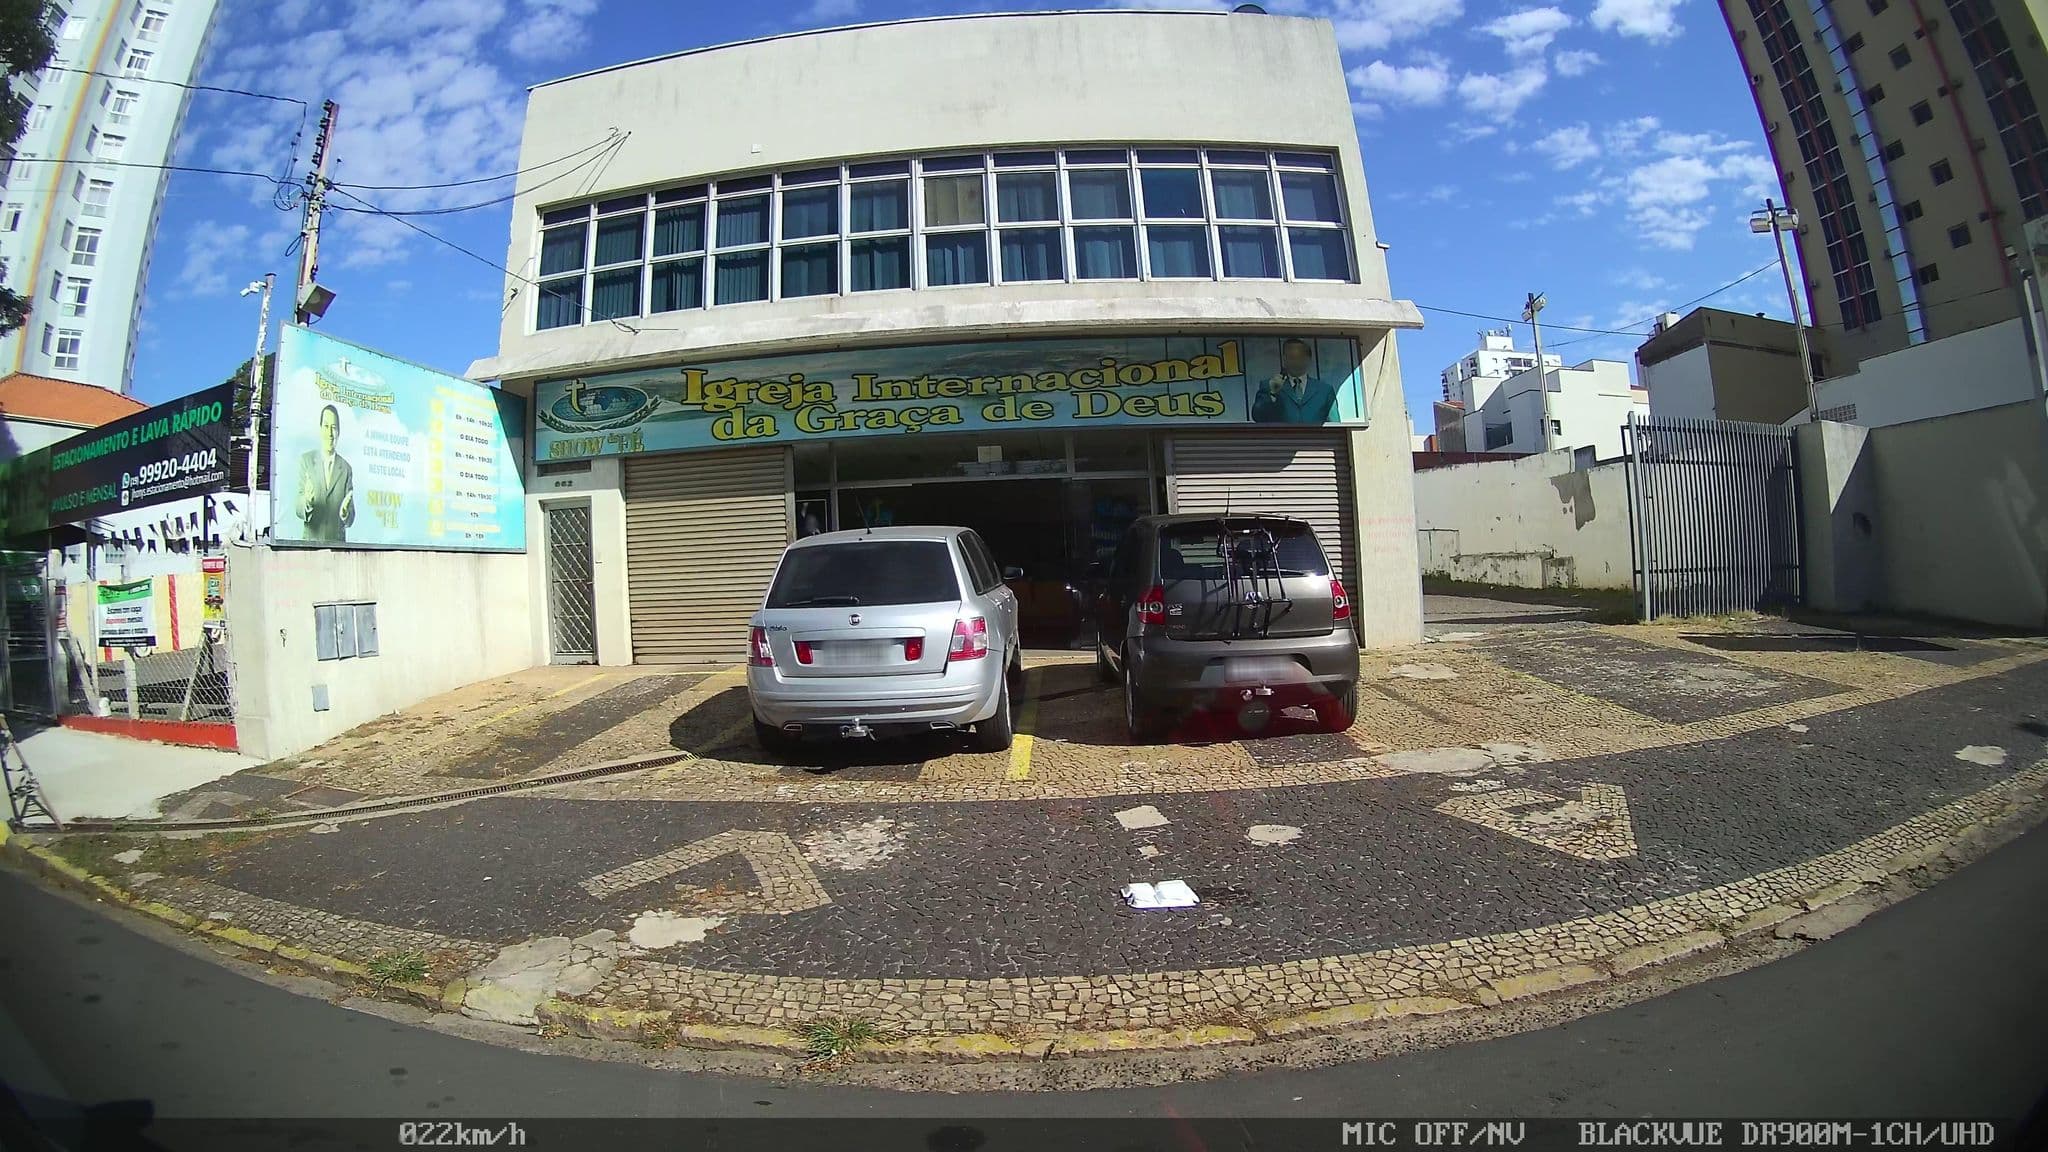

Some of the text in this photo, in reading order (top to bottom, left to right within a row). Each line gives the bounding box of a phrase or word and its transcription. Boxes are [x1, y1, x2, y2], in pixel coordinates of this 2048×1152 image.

[681, 339, 1245, 413] Igreja Internacional
[52, 401, 222, 471] ESTACIONAMENTO E LAVA RÁPIDO
[711, 387, 1227, 442] da Graça de Deus
[139, 447, 217, 485] 99920-4404
[550, 436, 606, 459] SHOW
